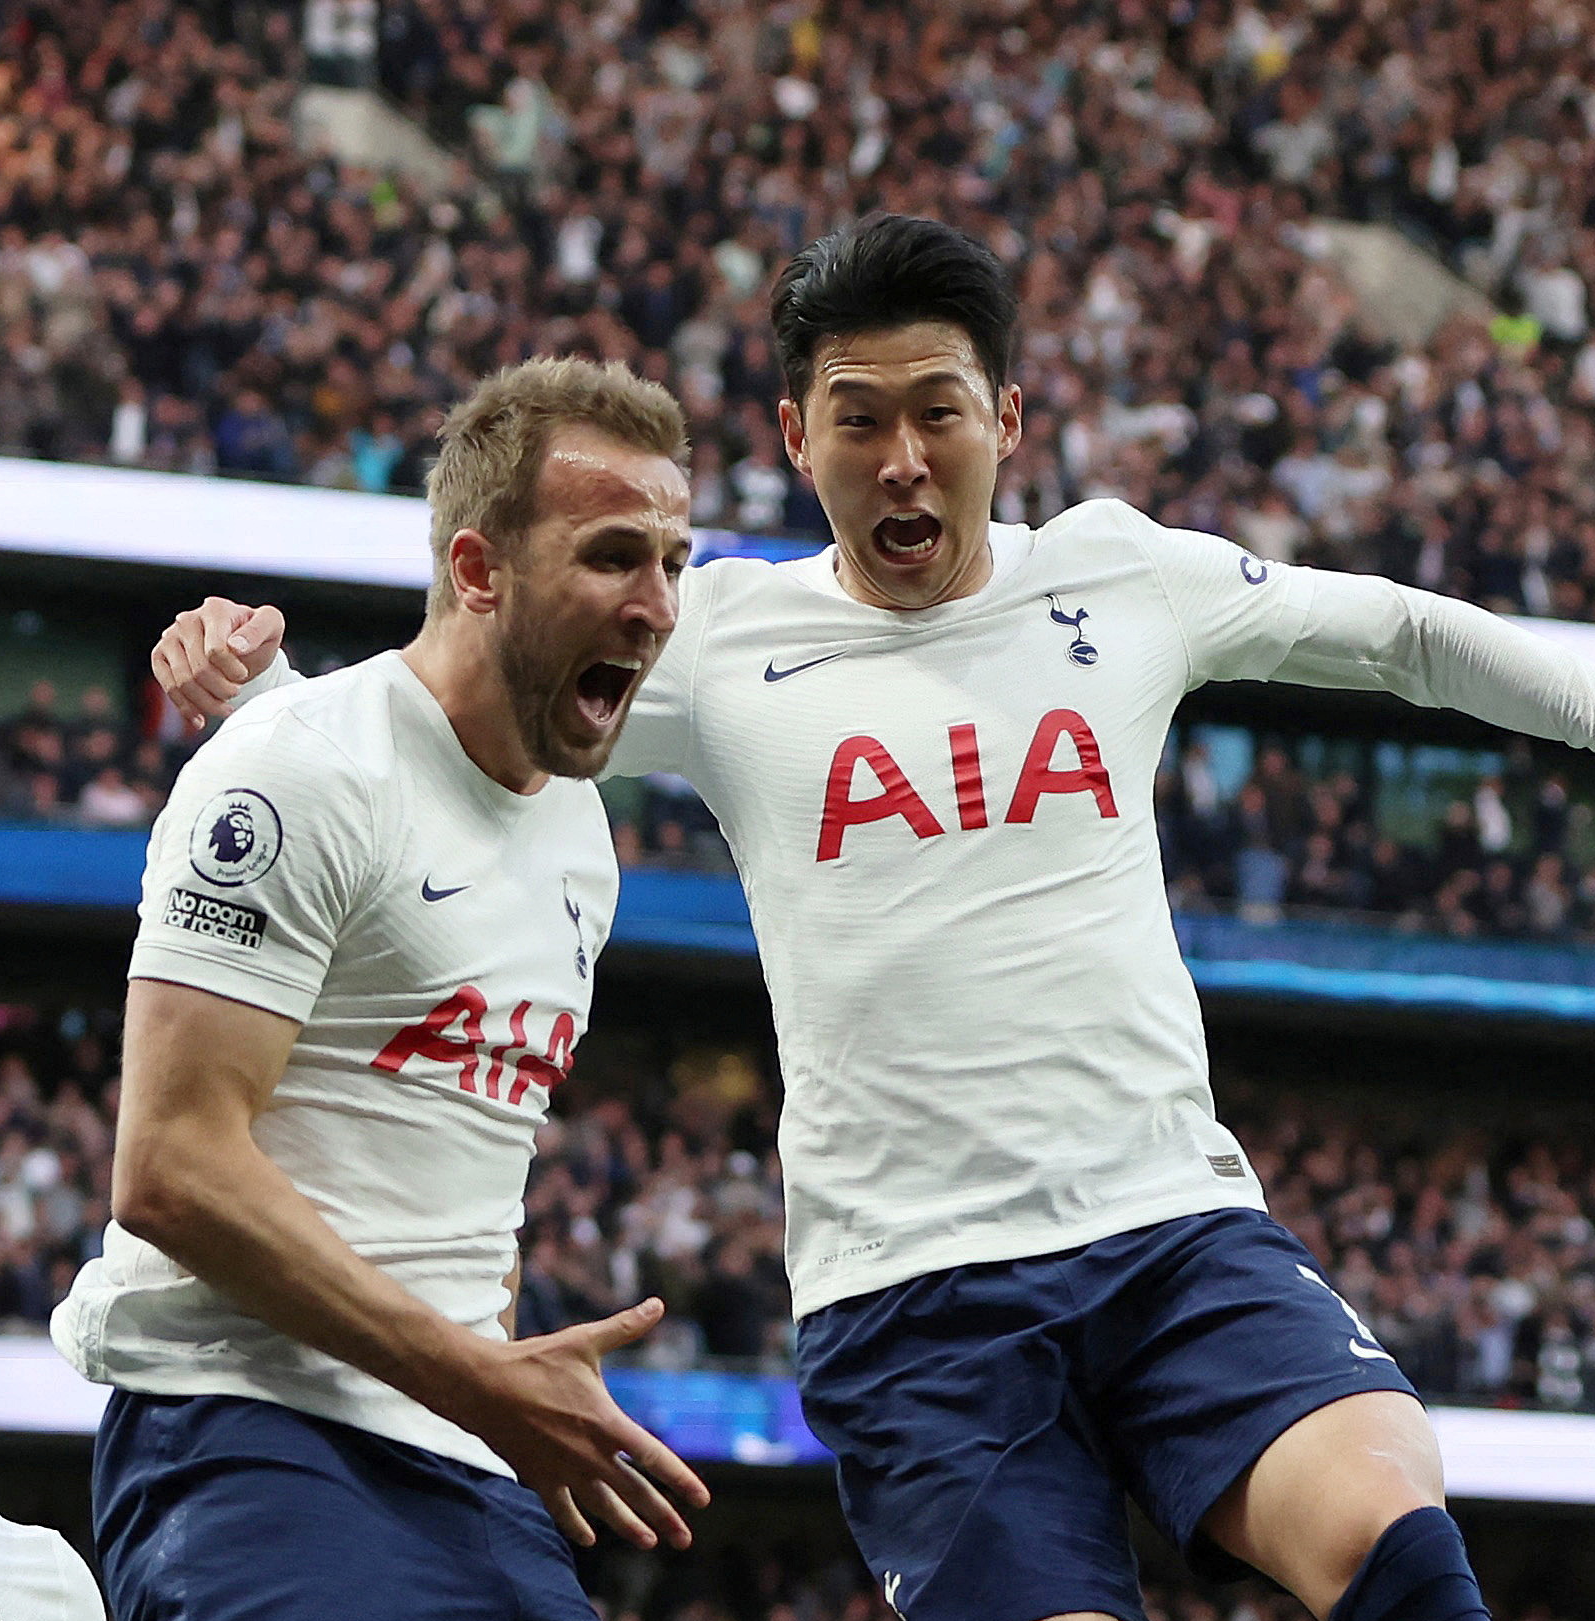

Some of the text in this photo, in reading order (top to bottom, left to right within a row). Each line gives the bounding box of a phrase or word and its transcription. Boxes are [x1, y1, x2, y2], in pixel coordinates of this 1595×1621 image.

[816, 708, 1120, 863] AIA
[168, 889, 256, 930] No room
[191, 918, 261, 949] racism
[370, 984, 575, 1106] AIA
